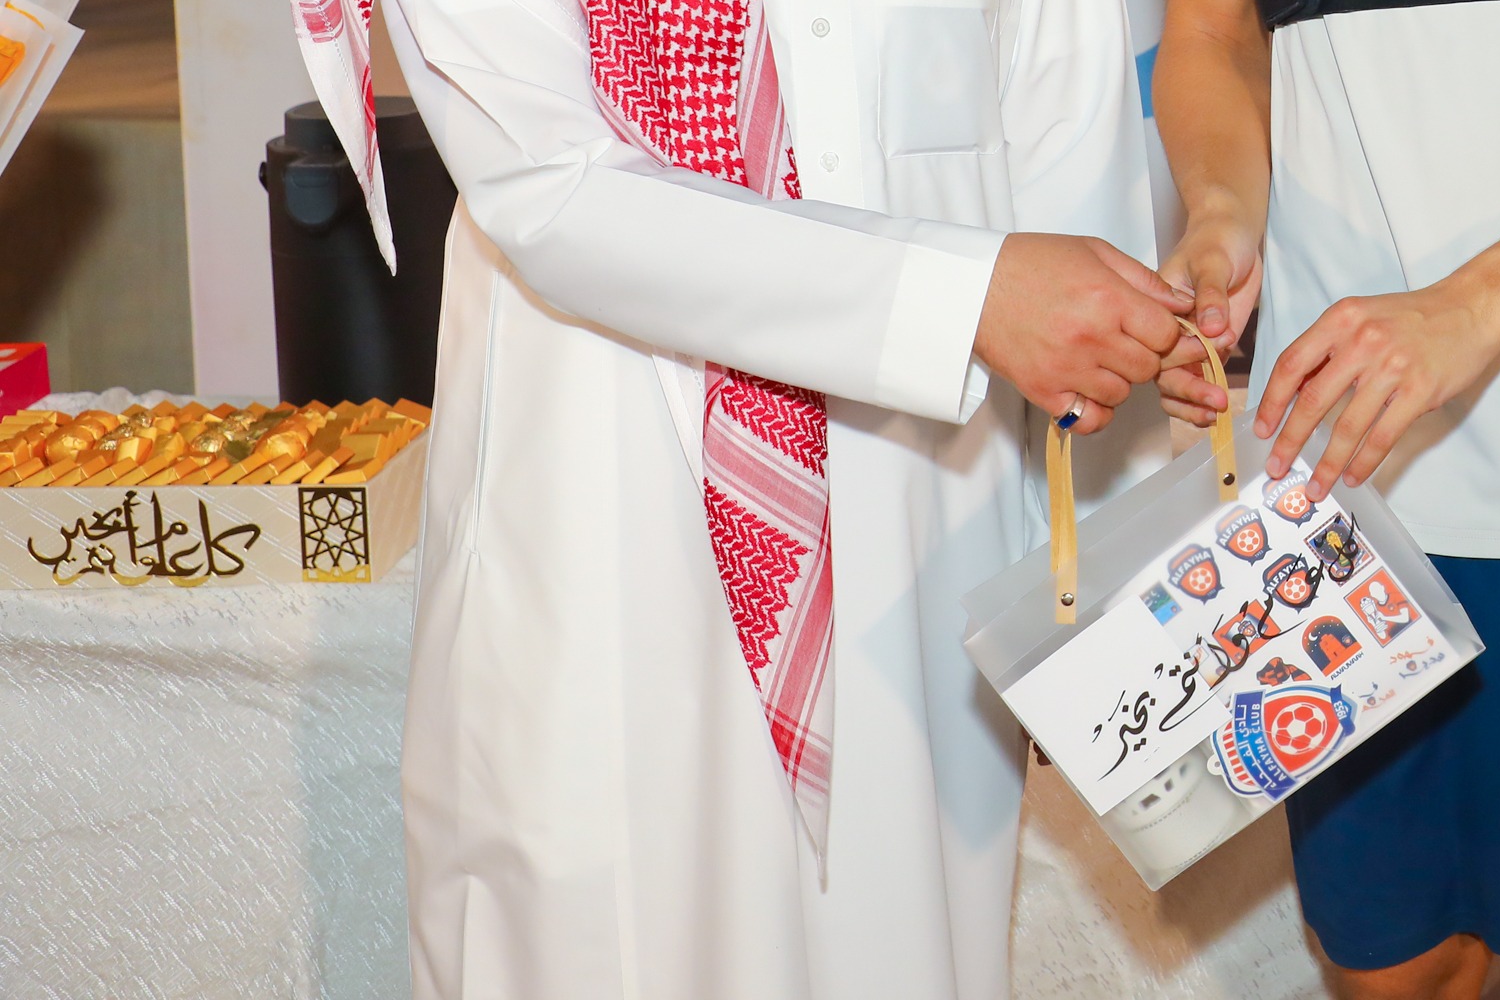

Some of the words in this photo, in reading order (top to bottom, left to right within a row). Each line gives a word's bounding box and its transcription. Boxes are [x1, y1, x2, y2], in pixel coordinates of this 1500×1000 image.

[1266, 474, 1306, 508] ALFAYHA
[1219, 512, 1259, 547] ALFAYHA
[1170, 550, 1212, 586] ALFAYHA
[1250, 703, 1261, 734] CLUB
[1333, 701, 1348, 720] 1953
[1254, 738, 1287, 782] ALFAYHA
